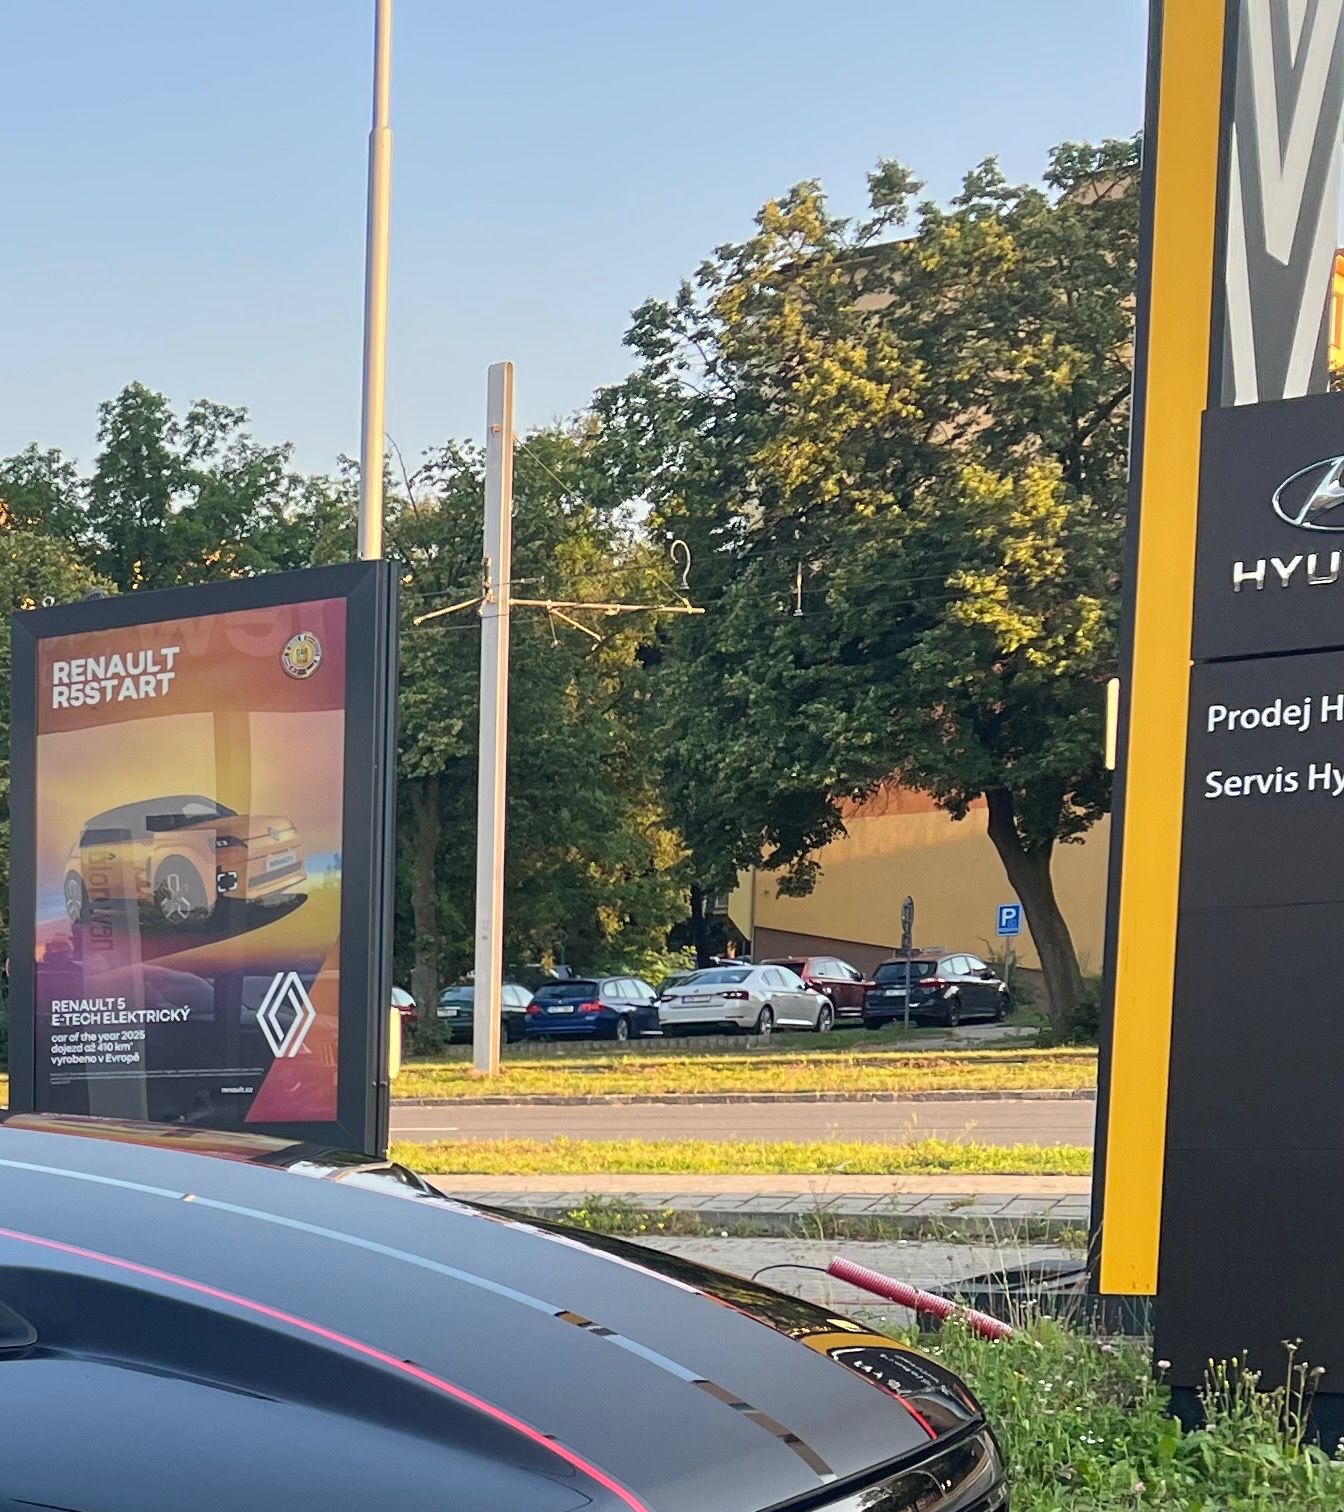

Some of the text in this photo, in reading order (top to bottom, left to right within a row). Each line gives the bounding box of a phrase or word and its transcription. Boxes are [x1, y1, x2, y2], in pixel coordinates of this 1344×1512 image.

[53, 646, 180, 685] RENAULT
[52, 672, 176, 709] R5START
[1207, 697, 1312, 732] Prodej
[1205, 766, 1299, 798] Servis
[1001, 907, 1017, 927] P
[52, 997, 126, 1013] RENAULT 5
[52, 1005, 191, 1027] E-TECH ELEKTRICKÝ
[51, 1029, 146, 1044] car of the year 2025
[97, 1042, 114, 1052] 410
[51, 1053, 98, 1066] vyrobeno
[105, 1051, 140, 1065] Evropě
